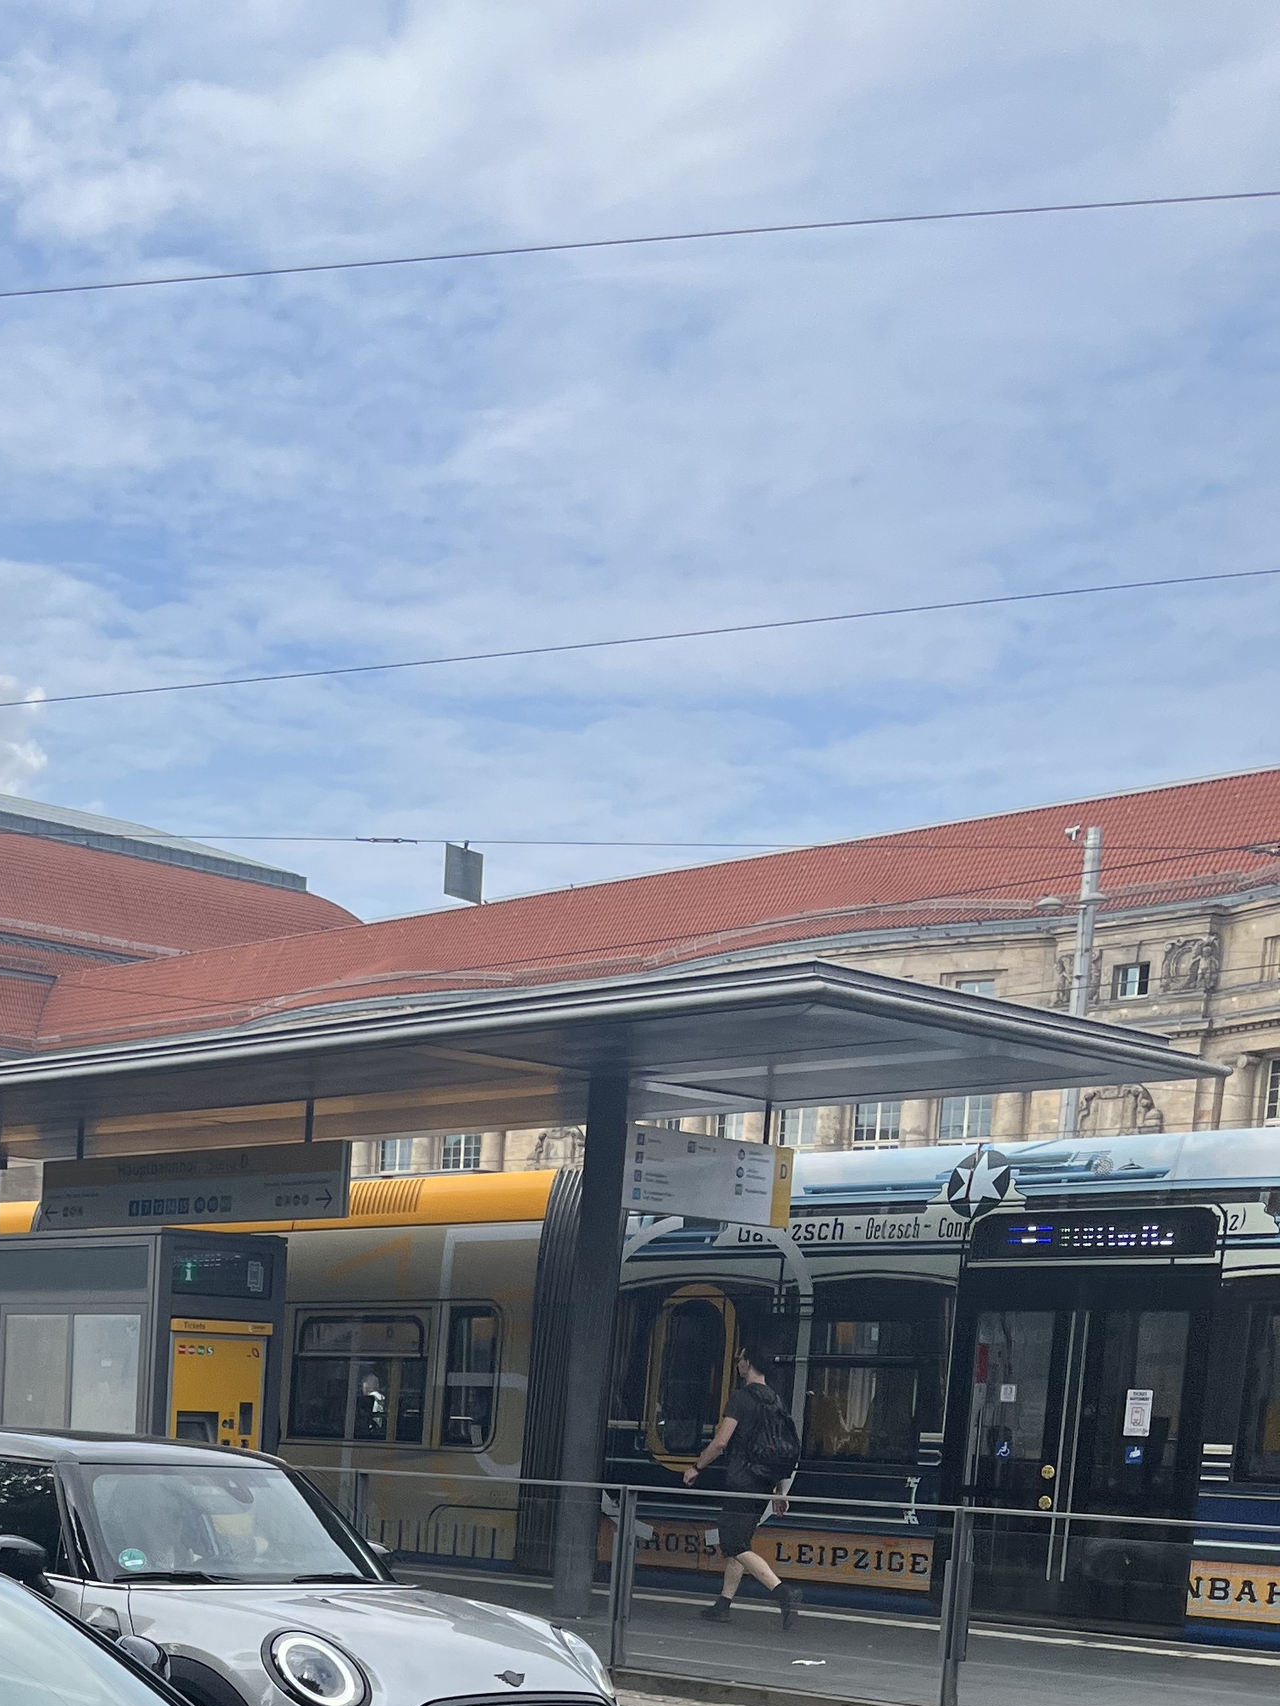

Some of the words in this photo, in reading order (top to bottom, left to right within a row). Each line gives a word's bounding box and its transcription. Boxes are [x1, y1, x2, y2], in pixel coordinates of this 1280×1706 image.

[779, 1163, 788, 1180] D
[183, 1321, 206, 1331] Tickets
[775, 1542, 929, 1575] LEIPZIGE
